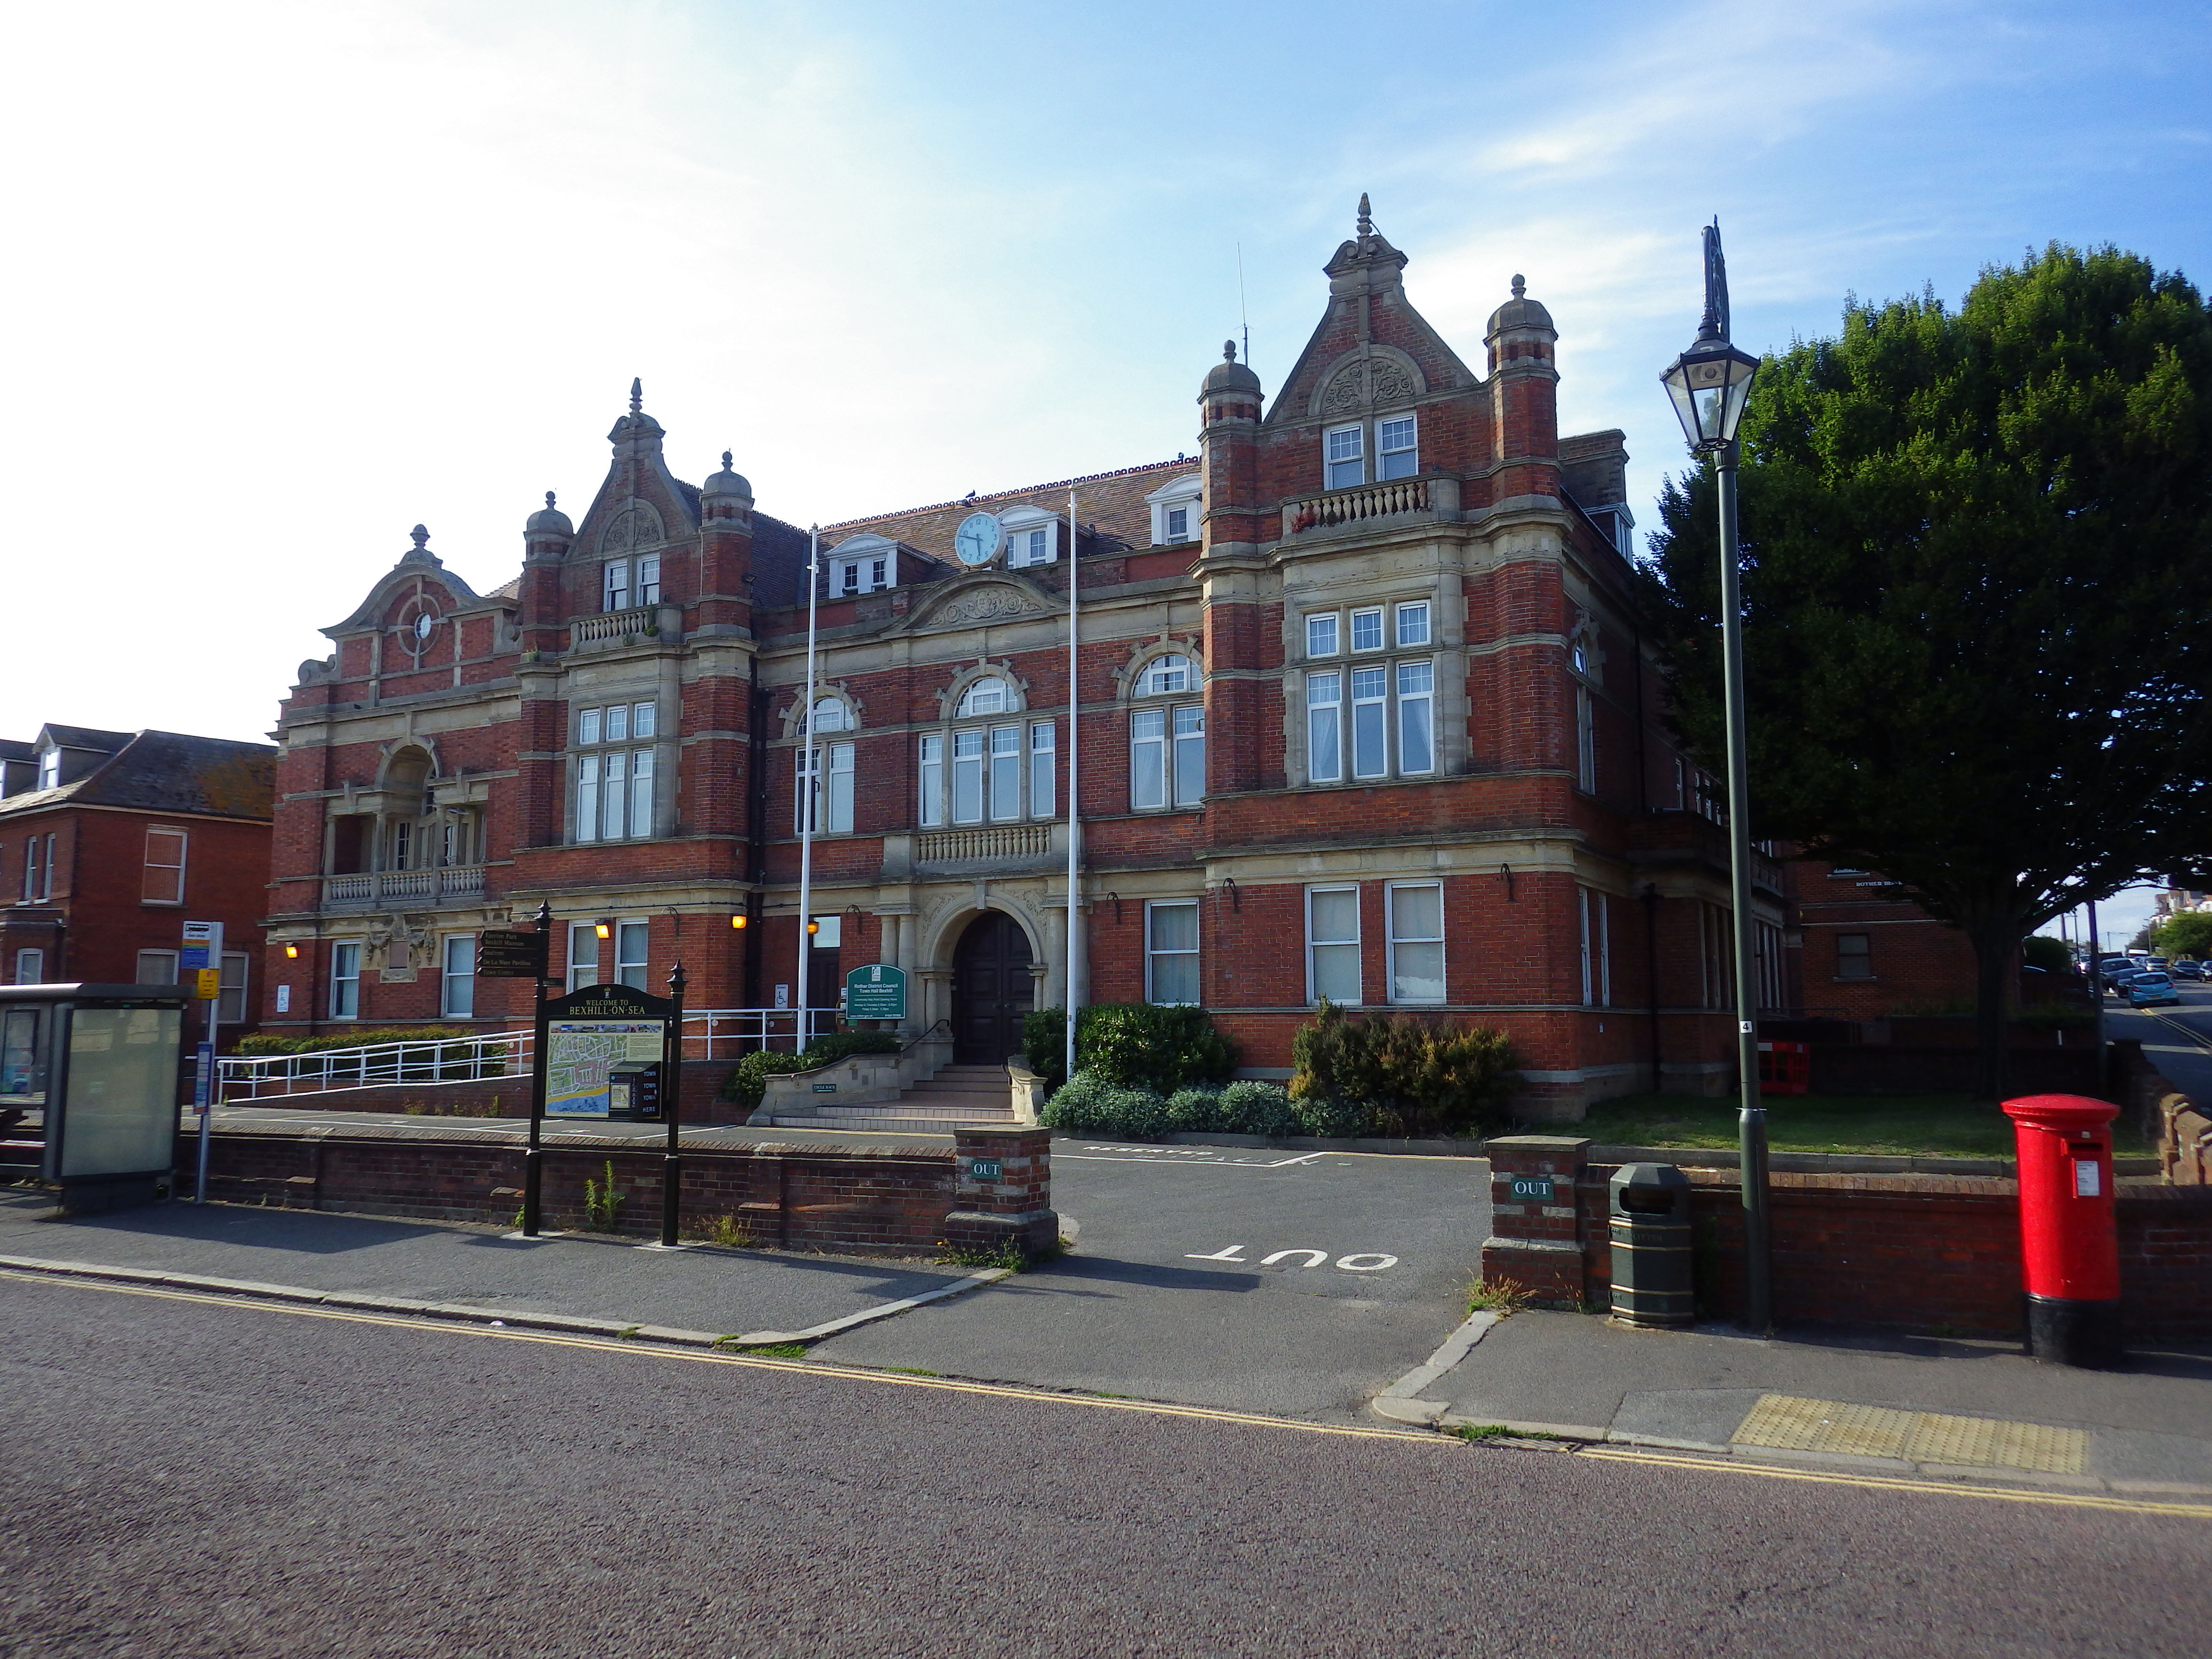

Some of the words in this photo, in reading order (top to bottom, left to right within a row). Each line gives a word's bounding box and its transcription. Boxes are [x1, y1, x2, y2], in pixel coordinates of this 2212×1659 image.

[569, 1006, 645, 1015] BEXHILL-ON-SEA
[1083, 1146, 1214, 1155] RESERVED
[974, 1163, 999, 1175] OUT
[1515, 1181, 1550, 1195] OUT
[1184, 1245, 1398, 1271] OUT
